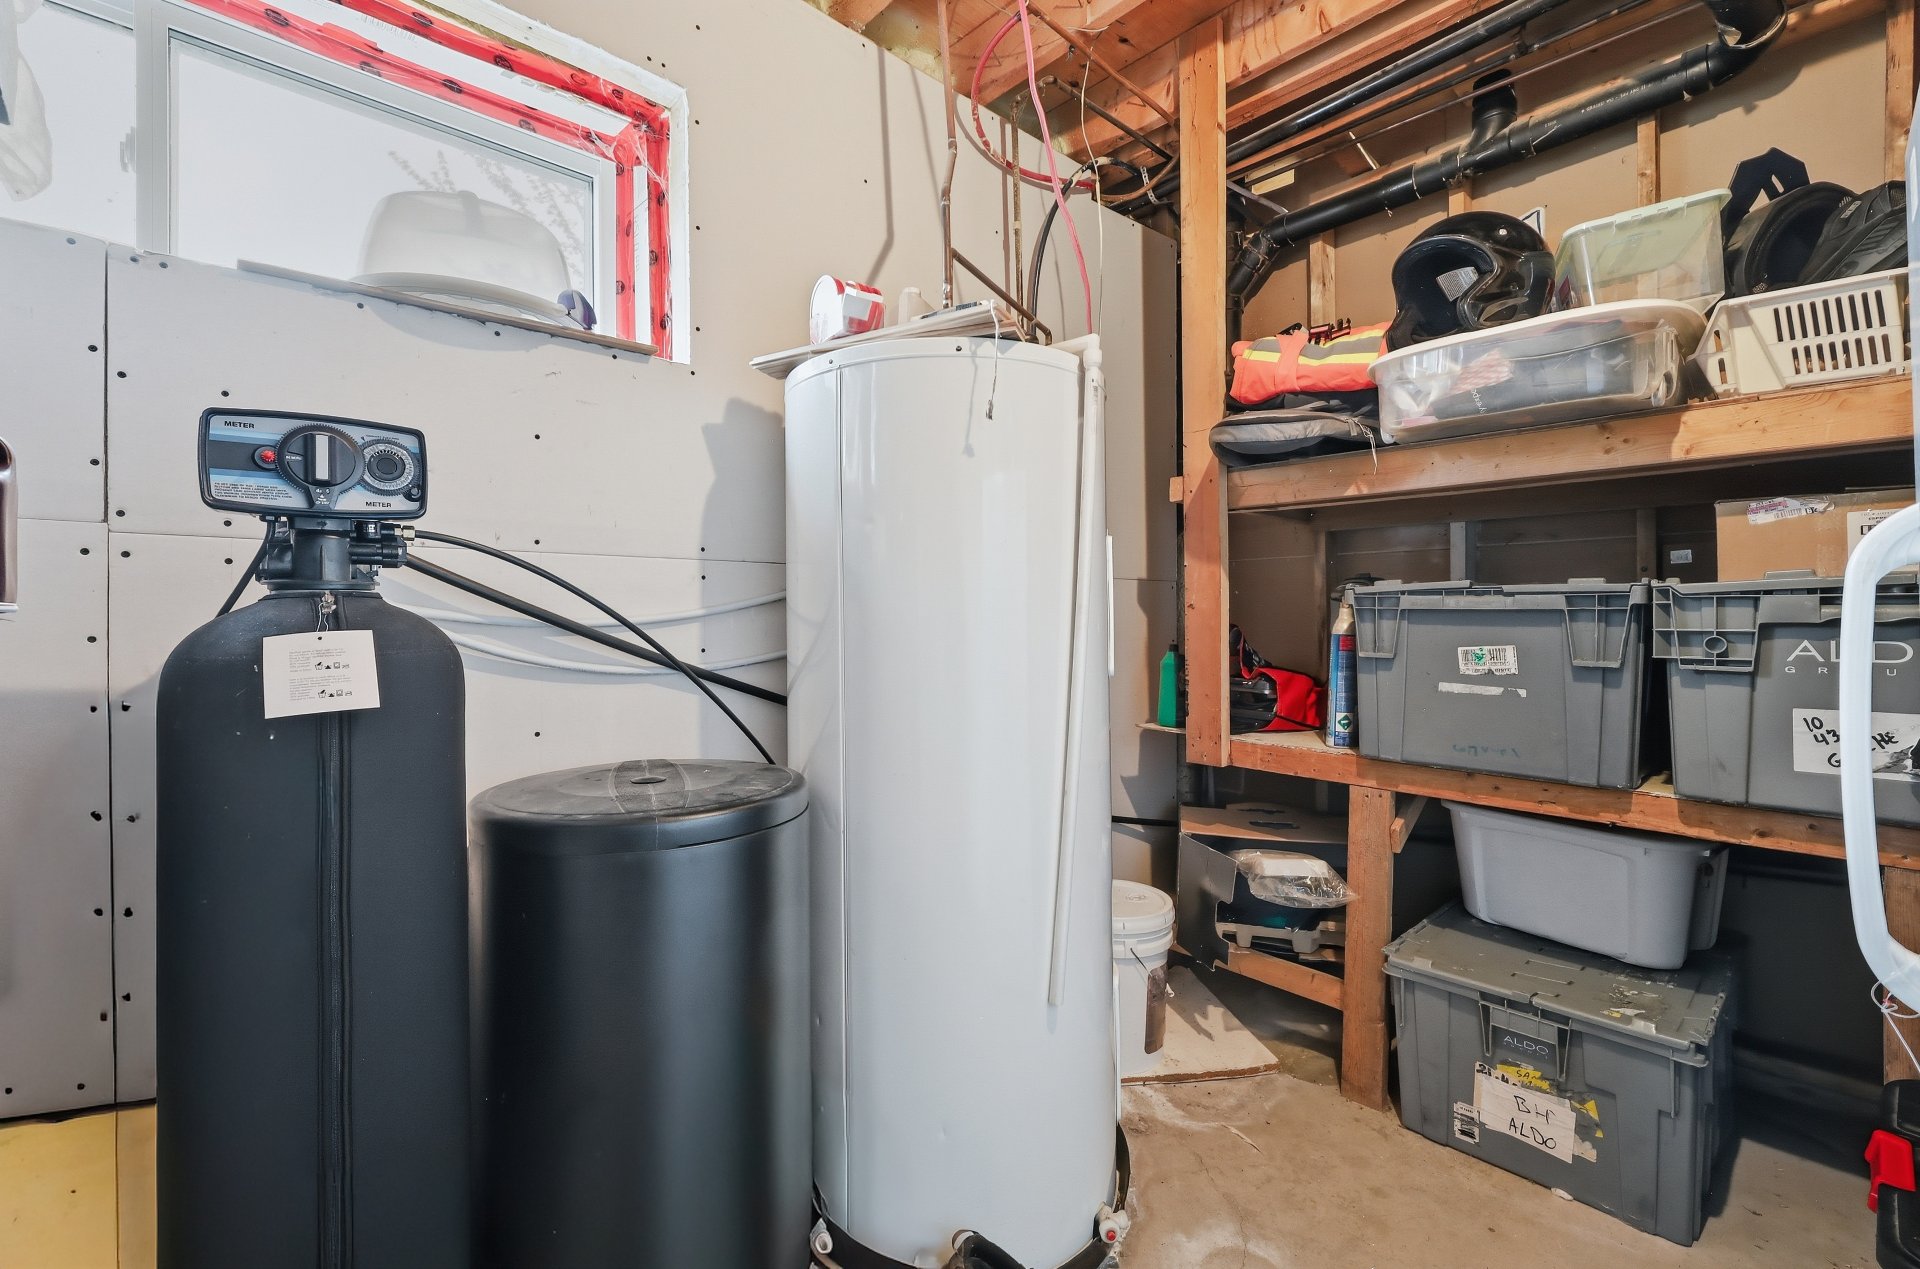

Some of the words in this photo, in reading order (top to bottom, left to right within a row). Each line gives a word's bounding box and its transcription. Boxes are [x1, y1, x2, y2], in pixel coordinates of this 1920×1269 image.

[224, 420, 255, 429] METER
[1503, 1035, 1549, 1055] ALDO
[1508, 1117, 1557, 1150] ALDO
